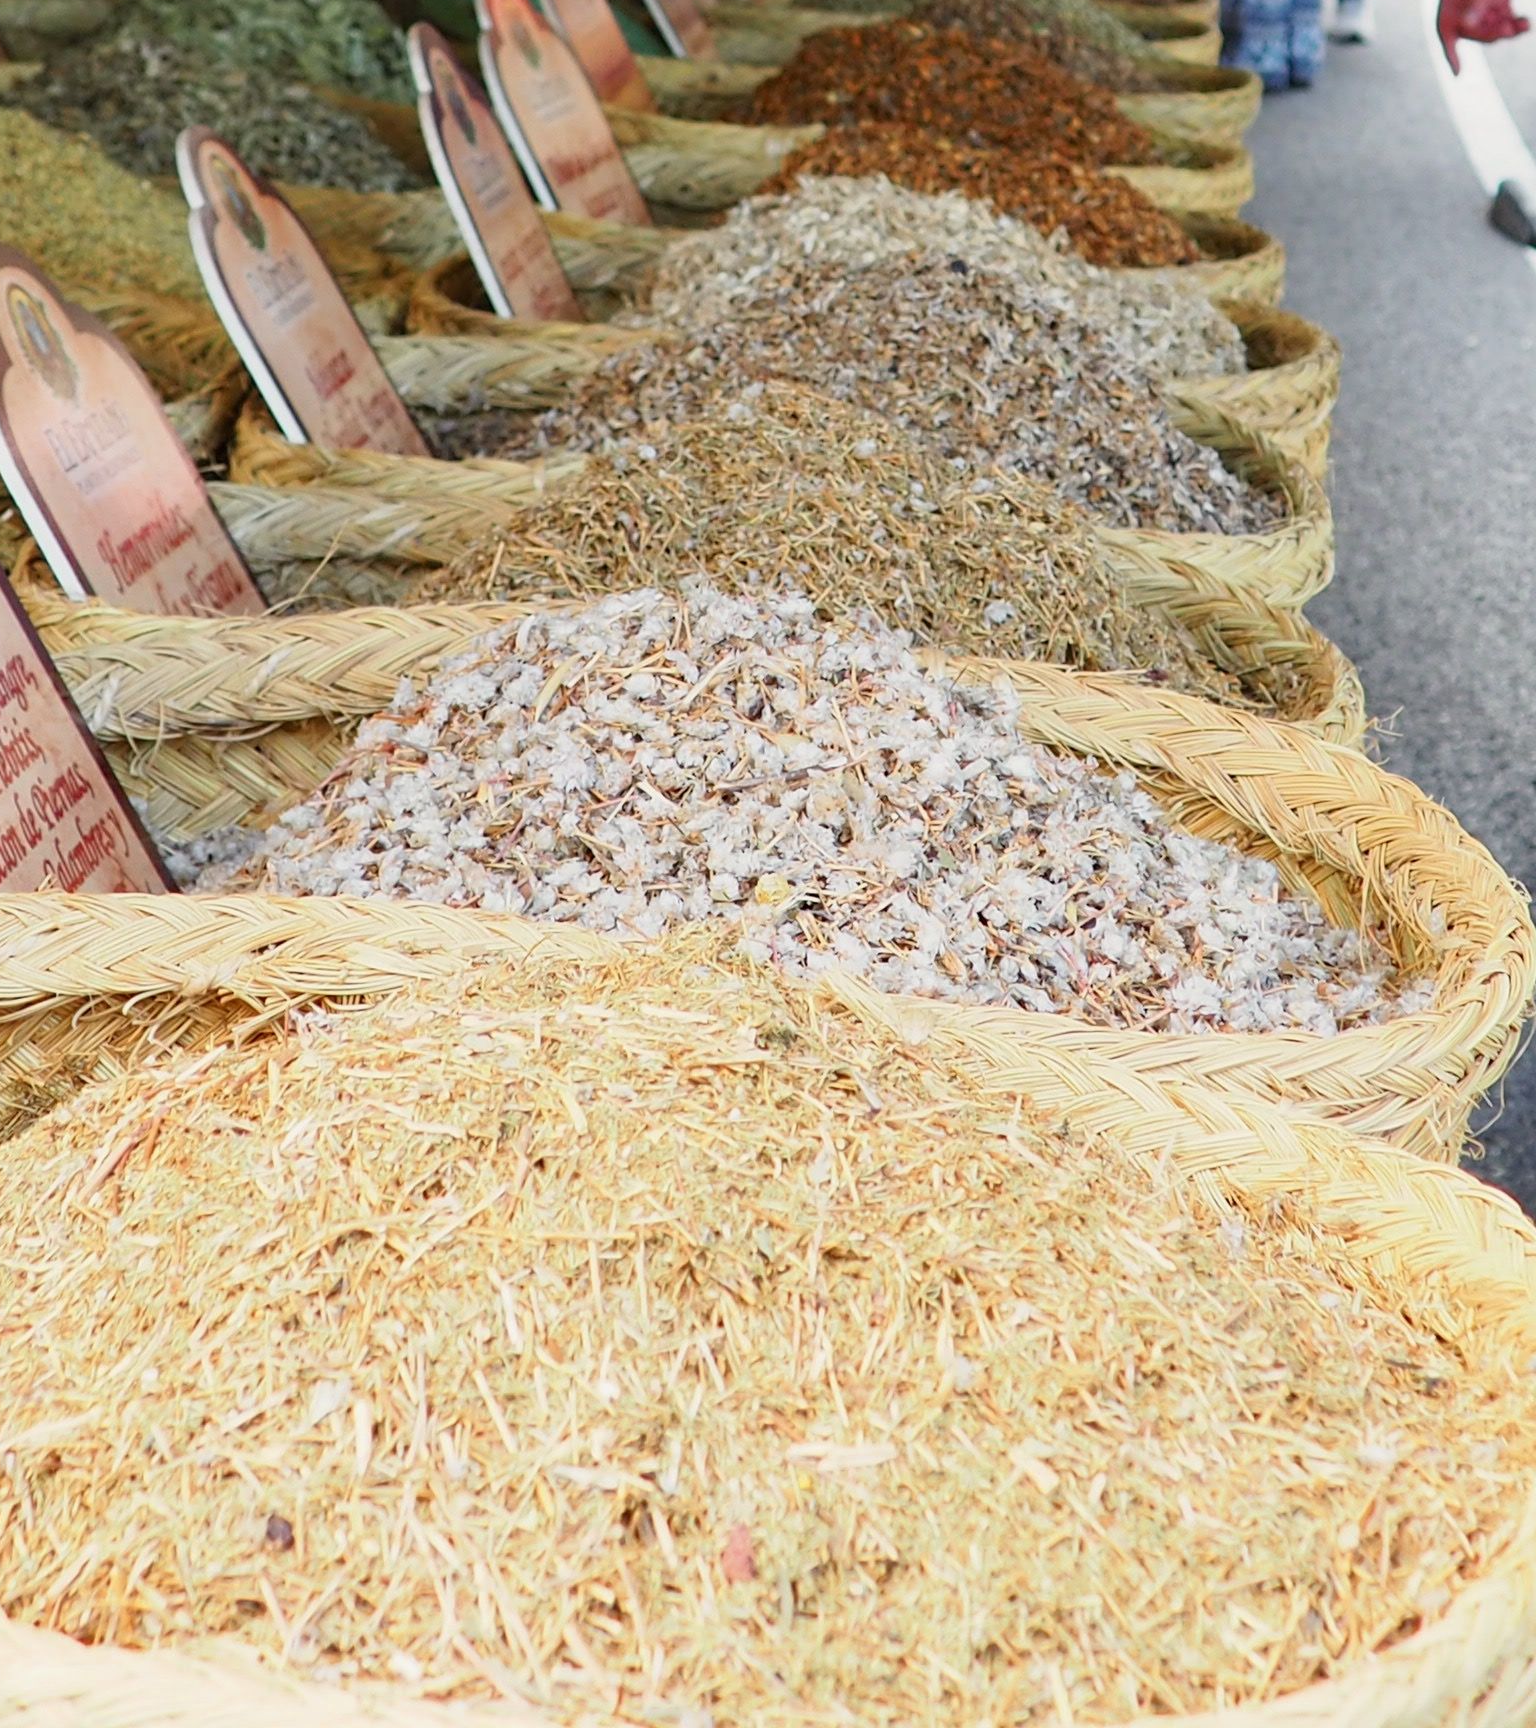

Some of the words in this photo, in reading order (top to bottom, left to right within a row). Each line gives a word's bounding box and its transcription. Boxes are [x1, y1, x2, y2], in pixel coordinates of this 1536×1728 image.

[14, 793, 43, 850] de
[29, 762, 94, 831] Piernas,
[106, 807, 129, 859] y
